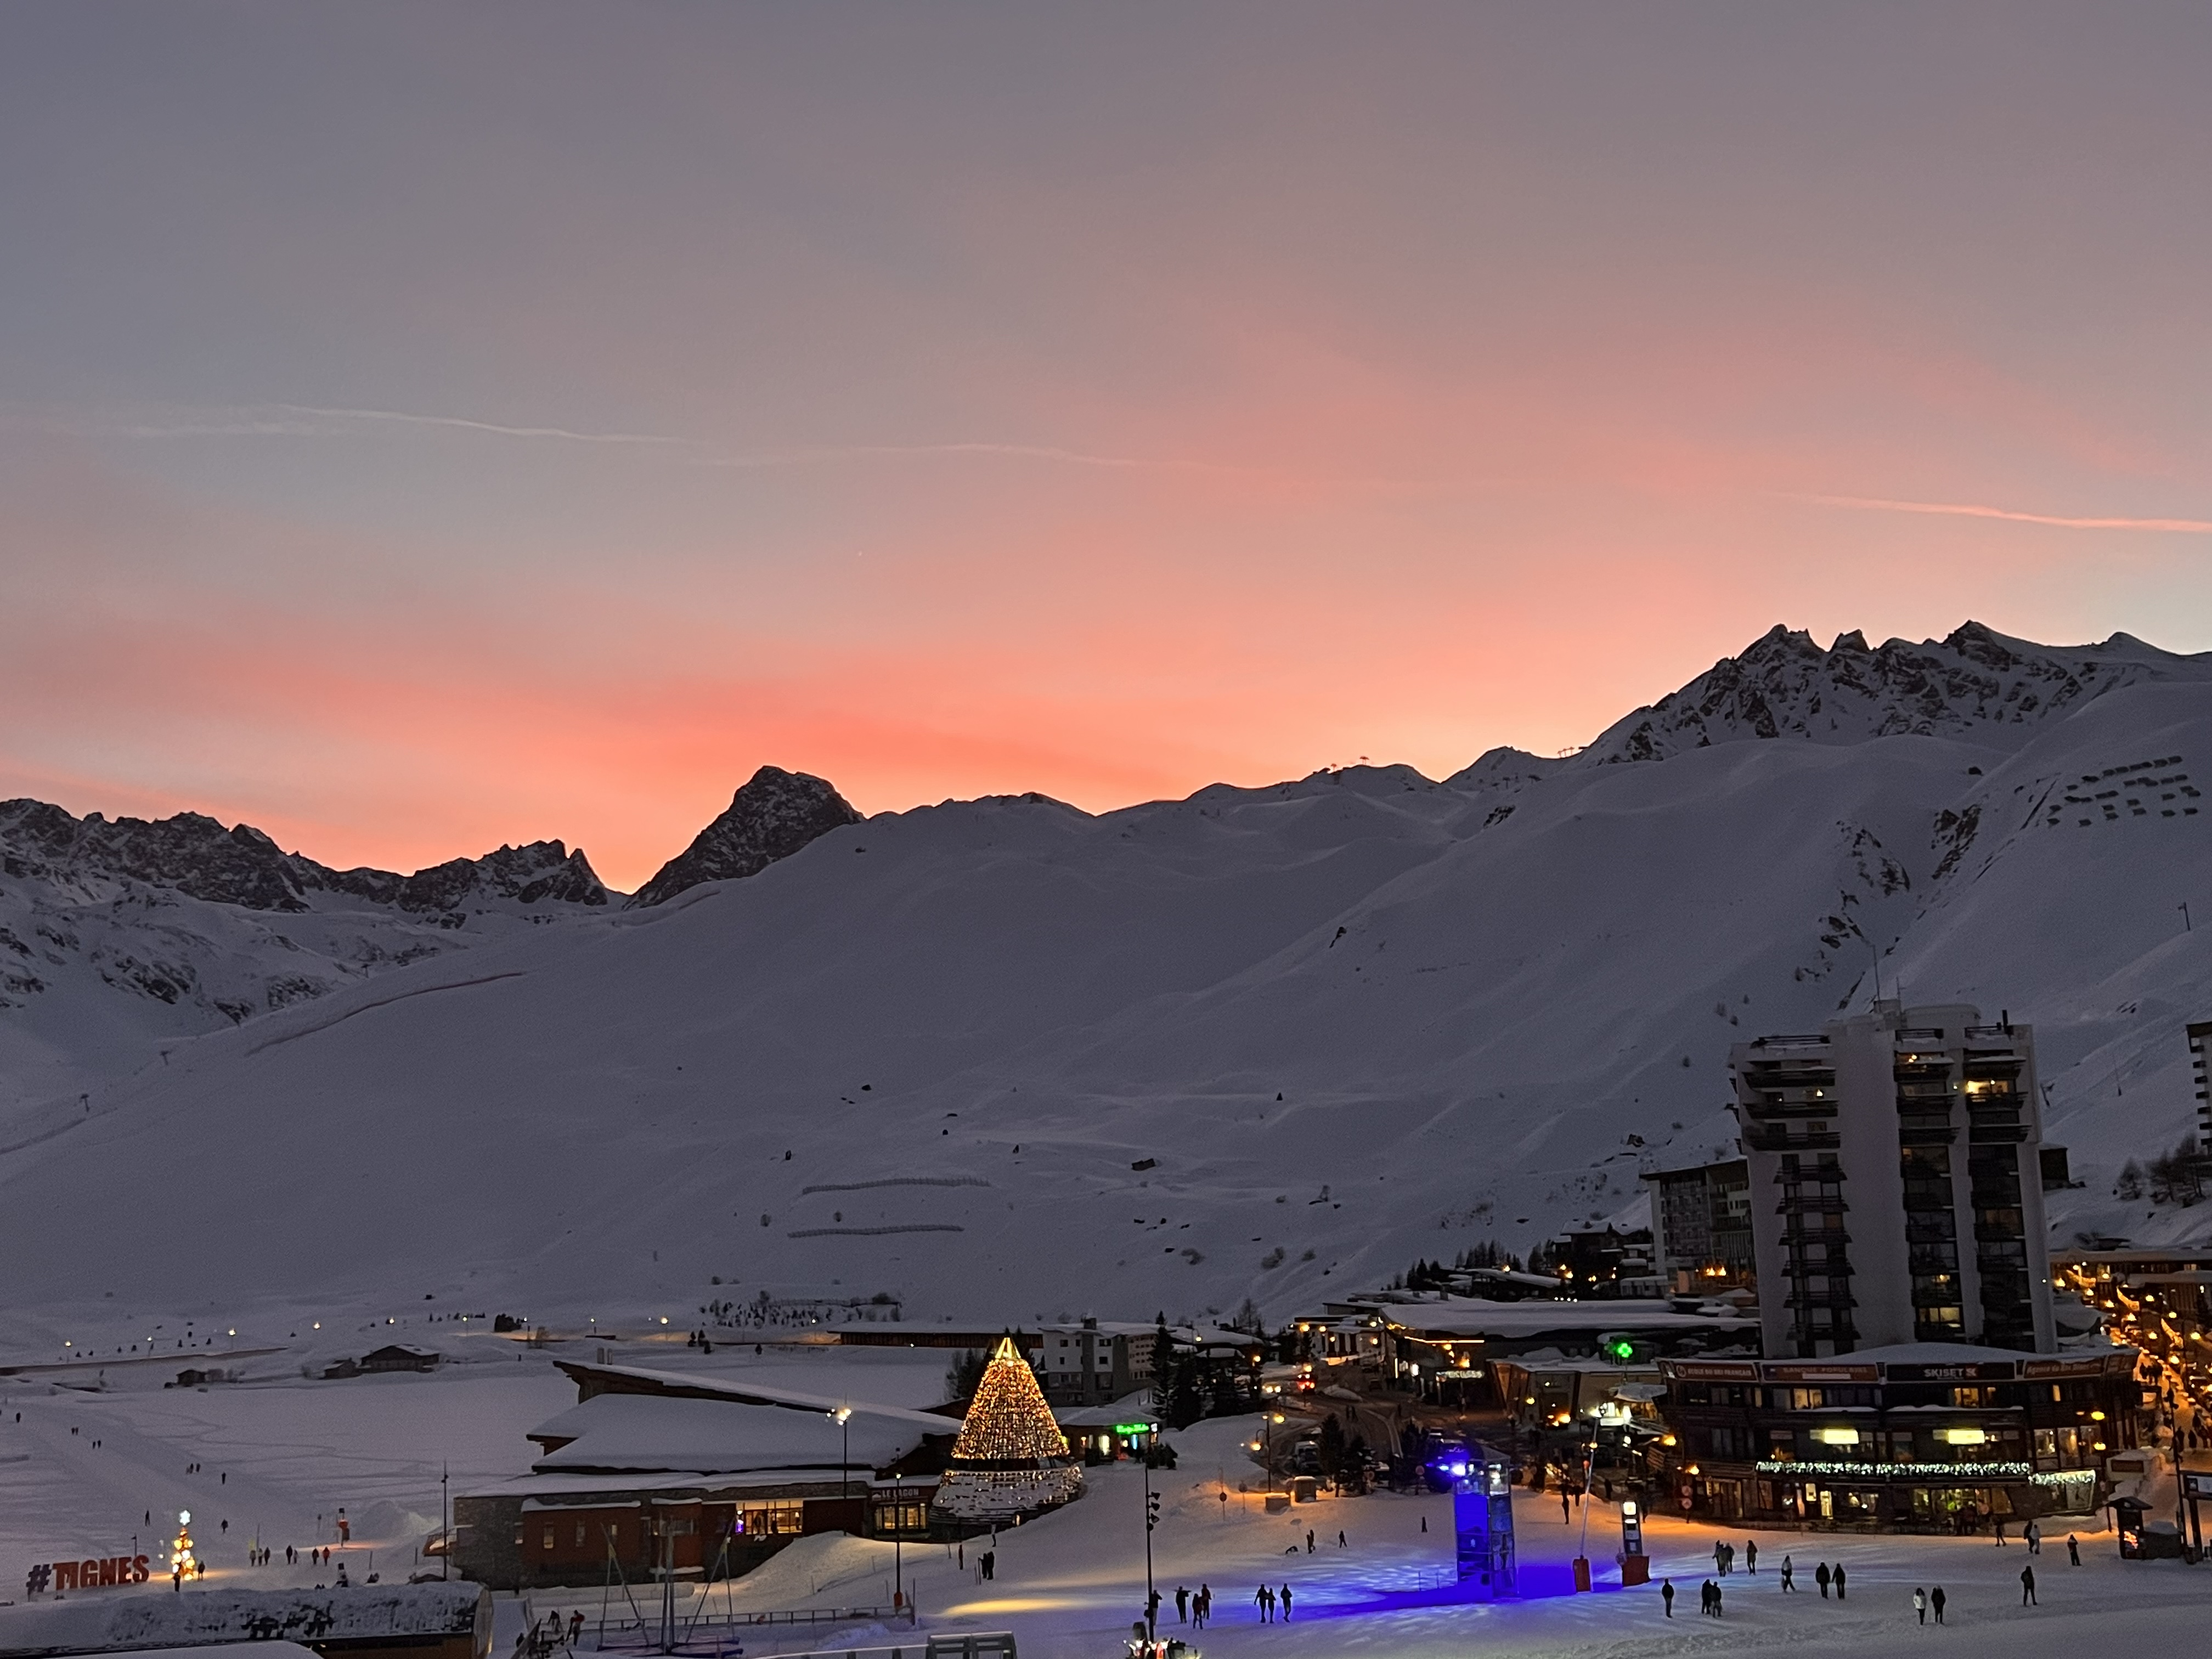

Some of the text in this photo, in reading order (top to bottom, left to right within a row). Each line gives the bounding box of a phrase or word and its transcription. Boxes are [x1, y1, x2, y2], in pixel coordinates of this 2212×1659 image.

[1924, 1368, 1964, 1378] SKISET
[882, 1488, 919, 1498] LE LAGON
[26, 1555, 150, 1592] #TIGNES
